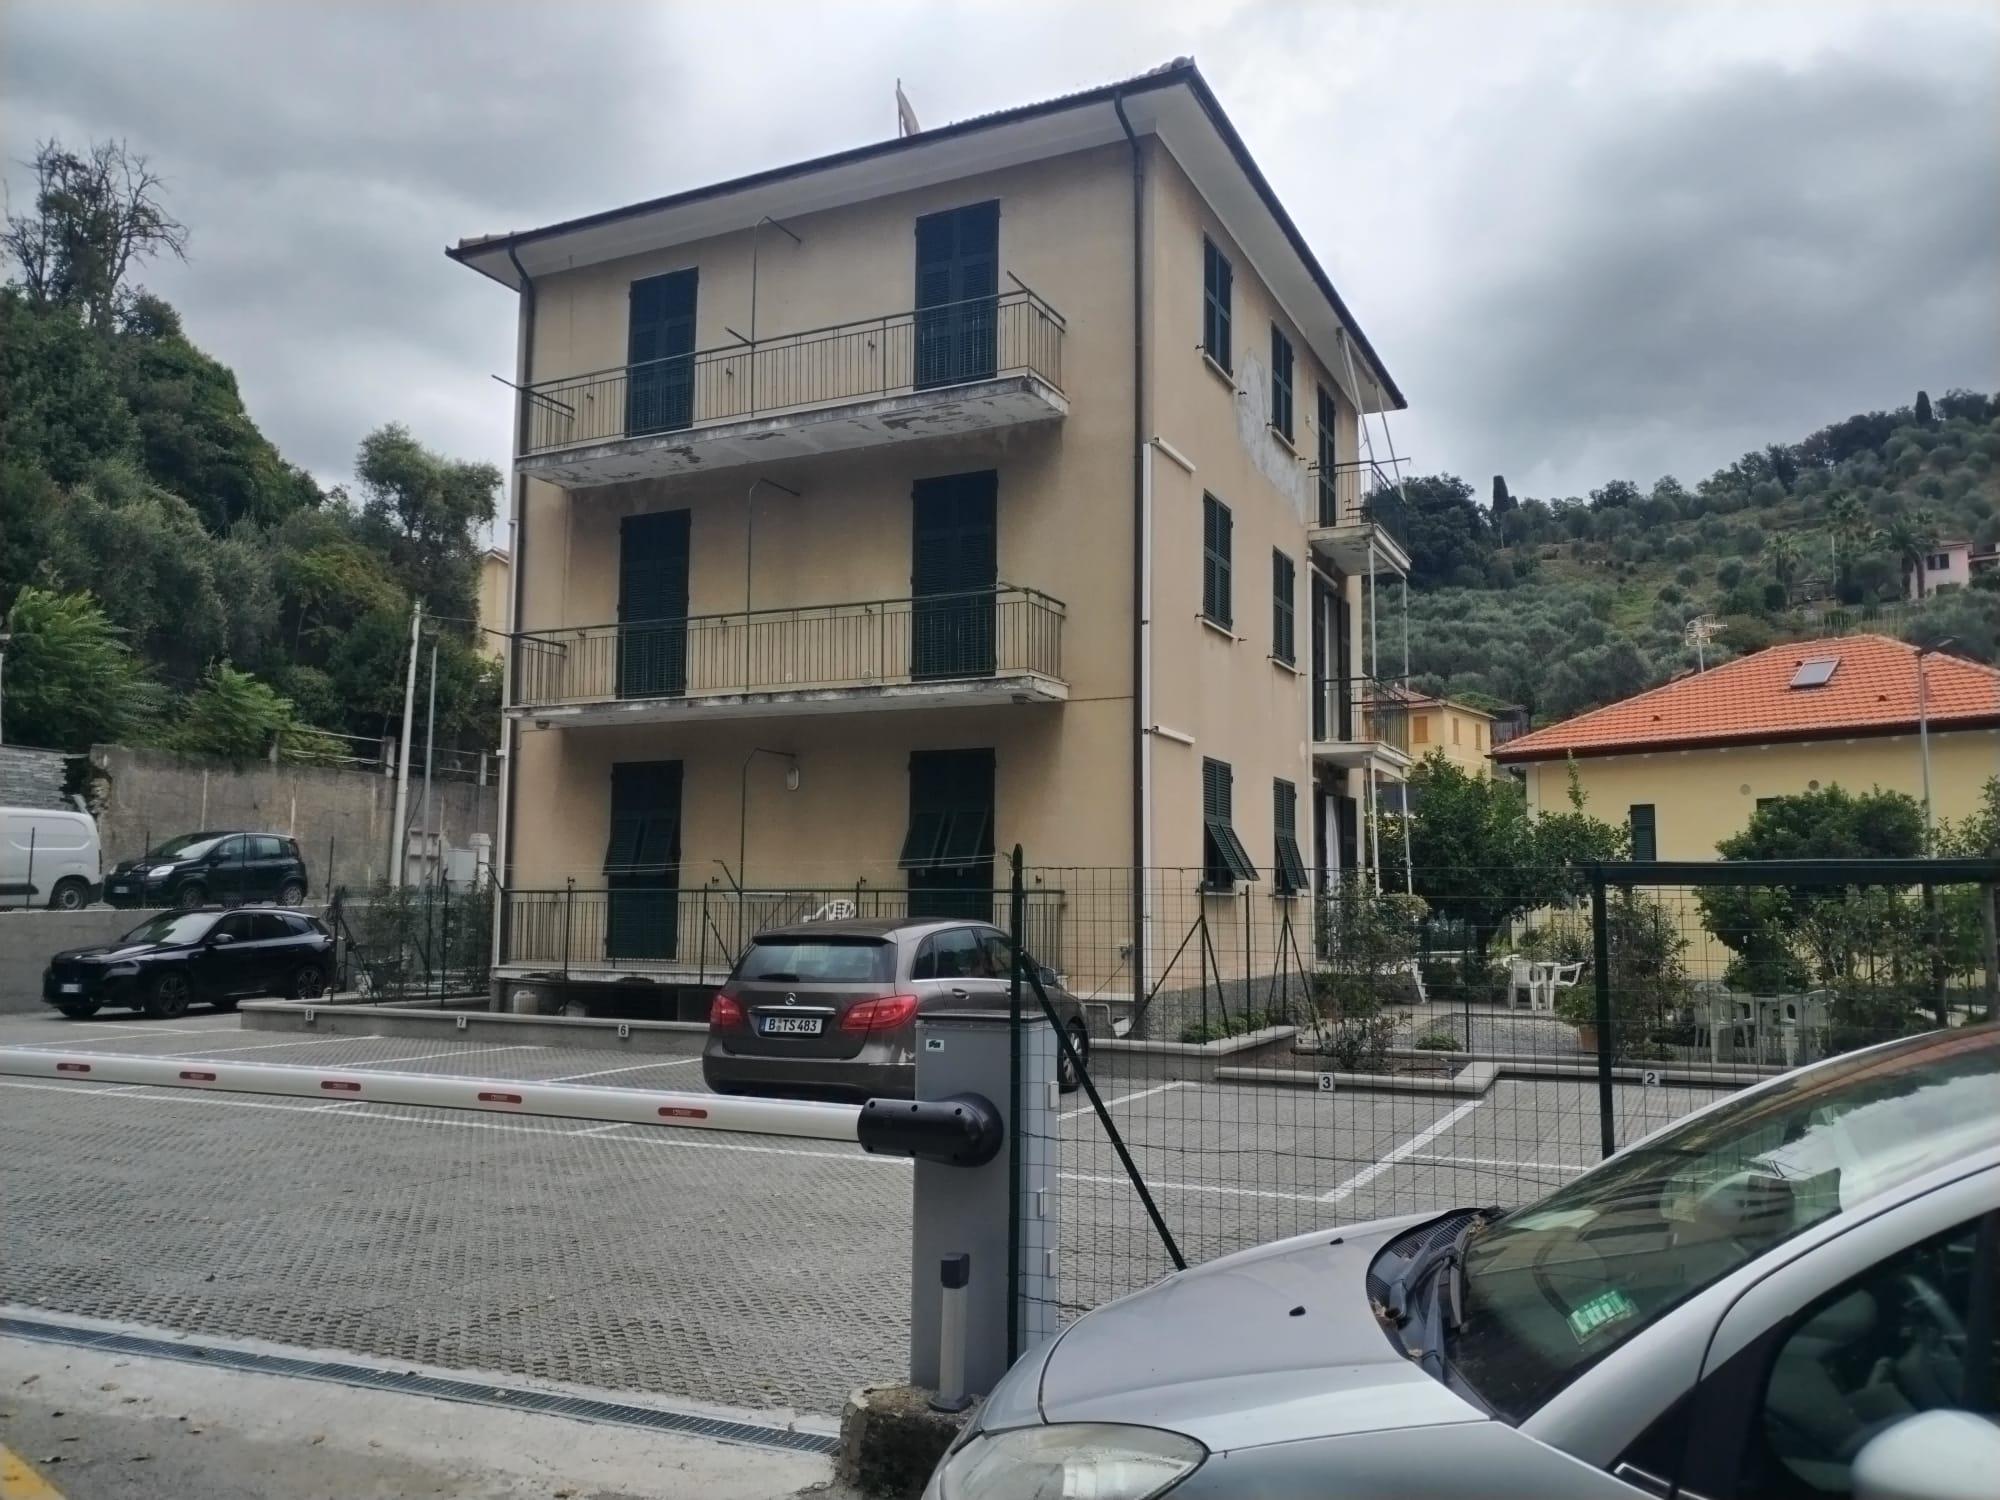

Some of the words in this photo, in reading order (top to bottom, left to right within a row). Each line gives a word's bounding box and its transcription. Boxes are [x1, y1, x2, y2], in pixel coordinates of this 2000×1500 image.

[768, 1018, 776, 1031] B
[1322, 1076, 1331, 1089] 3
[1646, 1072, 1656, 1084] 2
